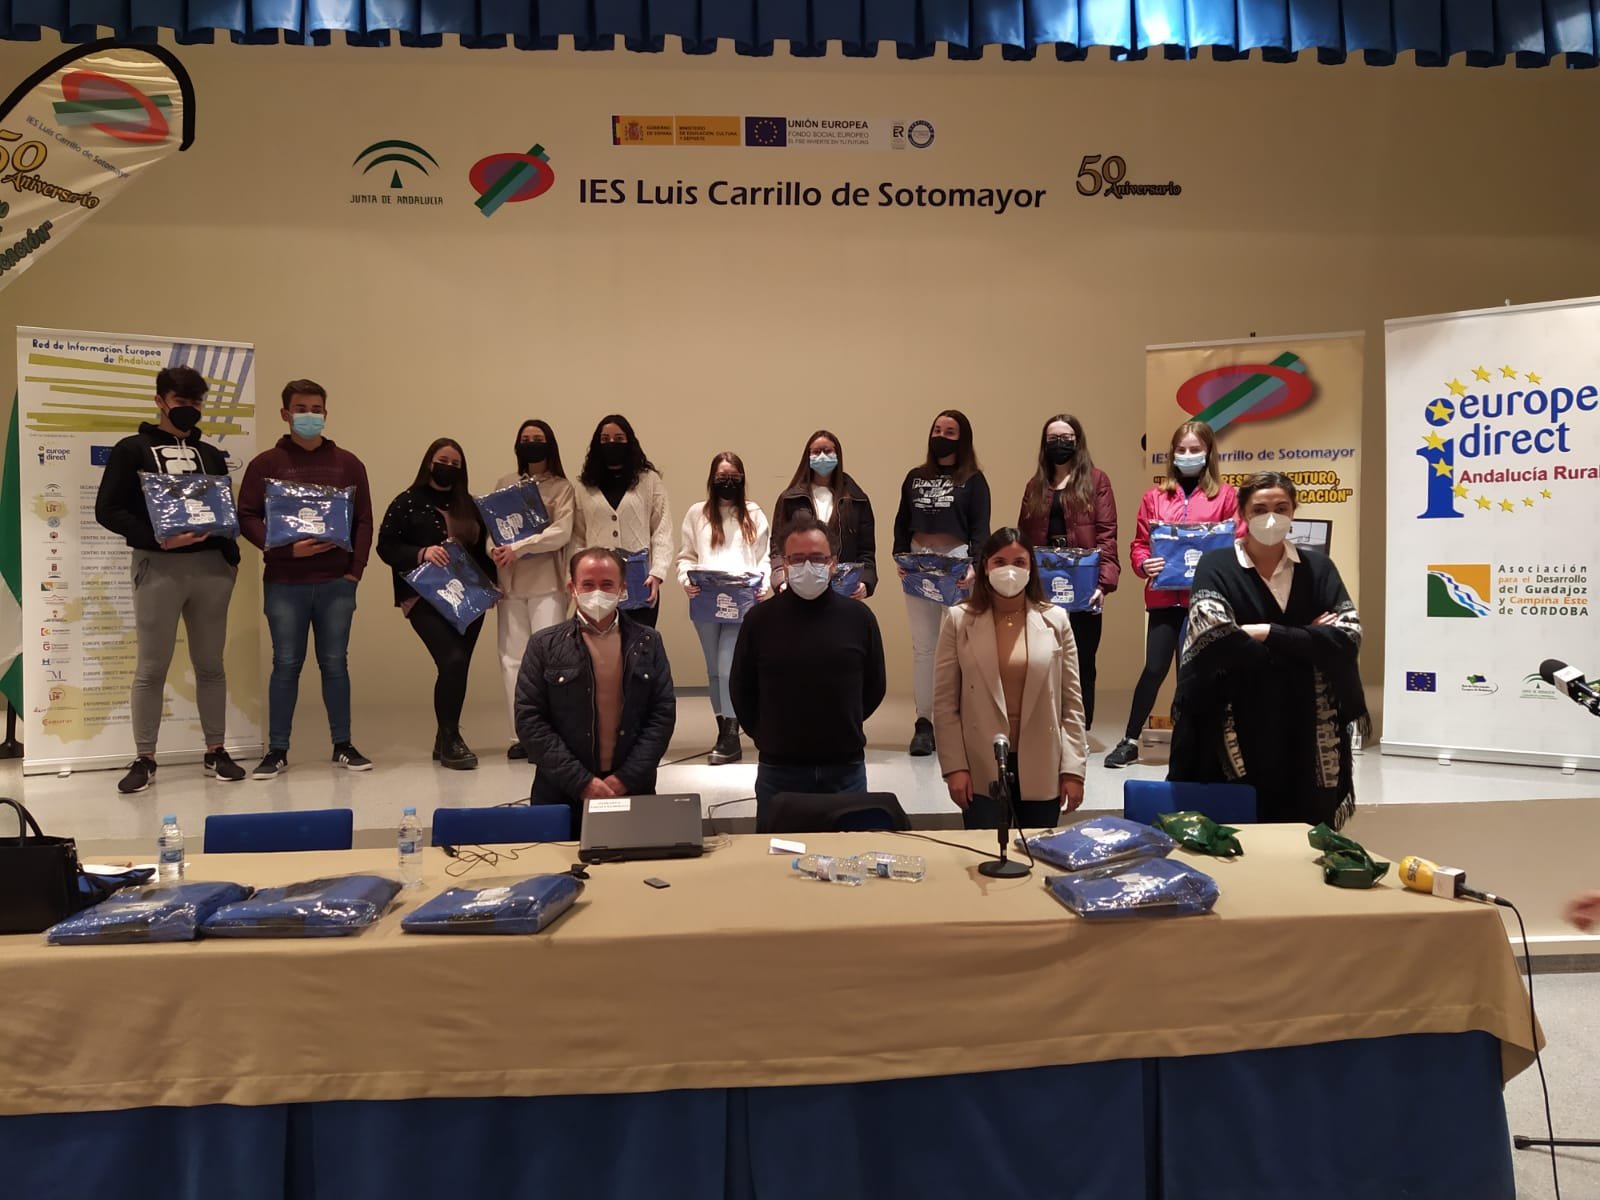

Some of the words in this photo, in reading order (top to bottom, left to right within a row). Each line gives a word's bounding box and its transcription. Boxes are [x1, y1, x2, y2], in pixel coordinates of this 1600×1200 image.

[787, 118, 819, 128] UNIÓN
[821, 120, 869, 129] EUROPEA
[55, 133, 82, 152] Carrillo
[1075, 154, 1127, 197] 50
[579, 178, 626, 204] IES
[637, 179, 698, 204] Luis
[708, 181, 822, 206] Carrillo
[831, 182, 871, 207] de
[877, 182, 1046, 214] Sotomayor
[1104, 181, 1182, 199] Aniversario
[350, 195, 377, 204] JUNTA
[381, 195, 392, 204] DE
[32, 338, 50, 349] Red
[53, 340, 64, 350] de
[125, 345, 161, 357] Europea
[103, 354, 115, 364] de
[1459, 385, 1599, 424] europe
[1459, 422, 1571, 458] direct
[46, 448, 71, 456] europe
[1258, 448, 1274, 460] de
[1278, 447, 1355, 462] Sotomayor
[1459, 467, 1548, 484] Andalucía
[1498, 564, 1587, 573] Asociación
[1536, 575, 1587, 583] Desarrollo
[1499, 585, 1518, 594] del
[1525, 585, 1587, 596] Guadajoz
[1499, 597, 1506, 605] y
[1563, 596, 1588, 605] Este
[1499, 606, 1514, 615] de
